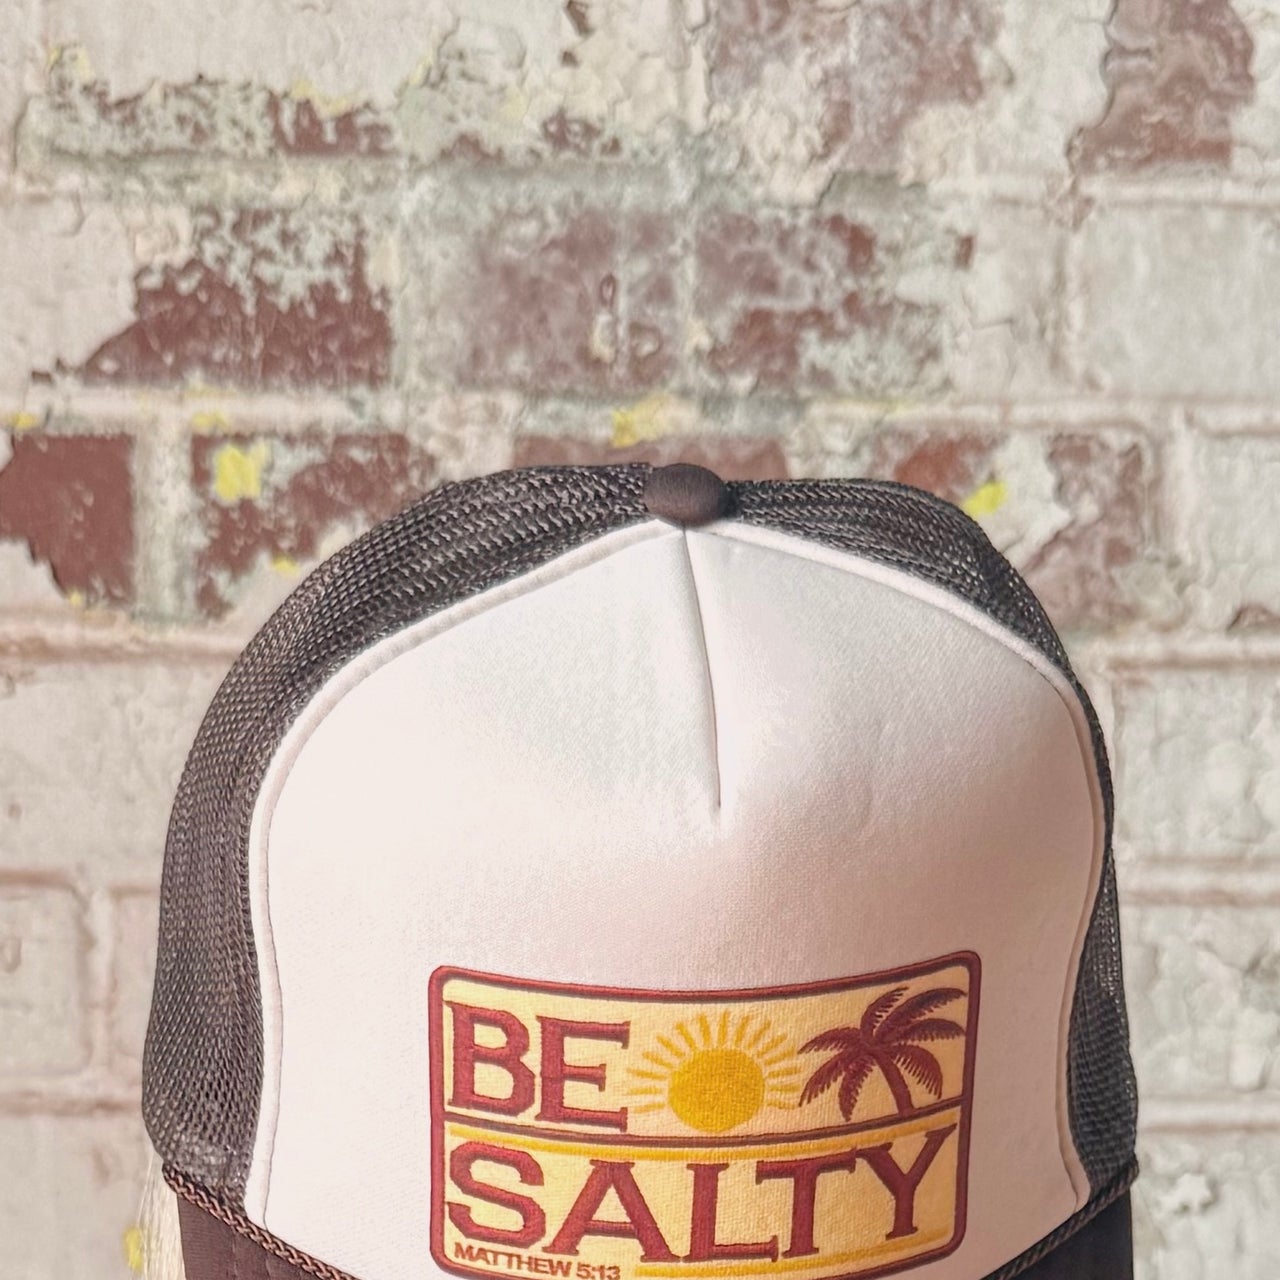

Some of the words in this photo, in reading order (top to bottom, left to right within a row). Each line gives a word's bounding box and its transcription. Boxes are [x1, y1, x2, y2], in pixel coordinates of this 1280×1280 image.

[445, 1000, 631, 1132] BE
[447, 1122, 958, 1263] SALTY
[454, 1241, 572, 1278] MATTHEW
[576, 1263, 621, 1280] 5:13
